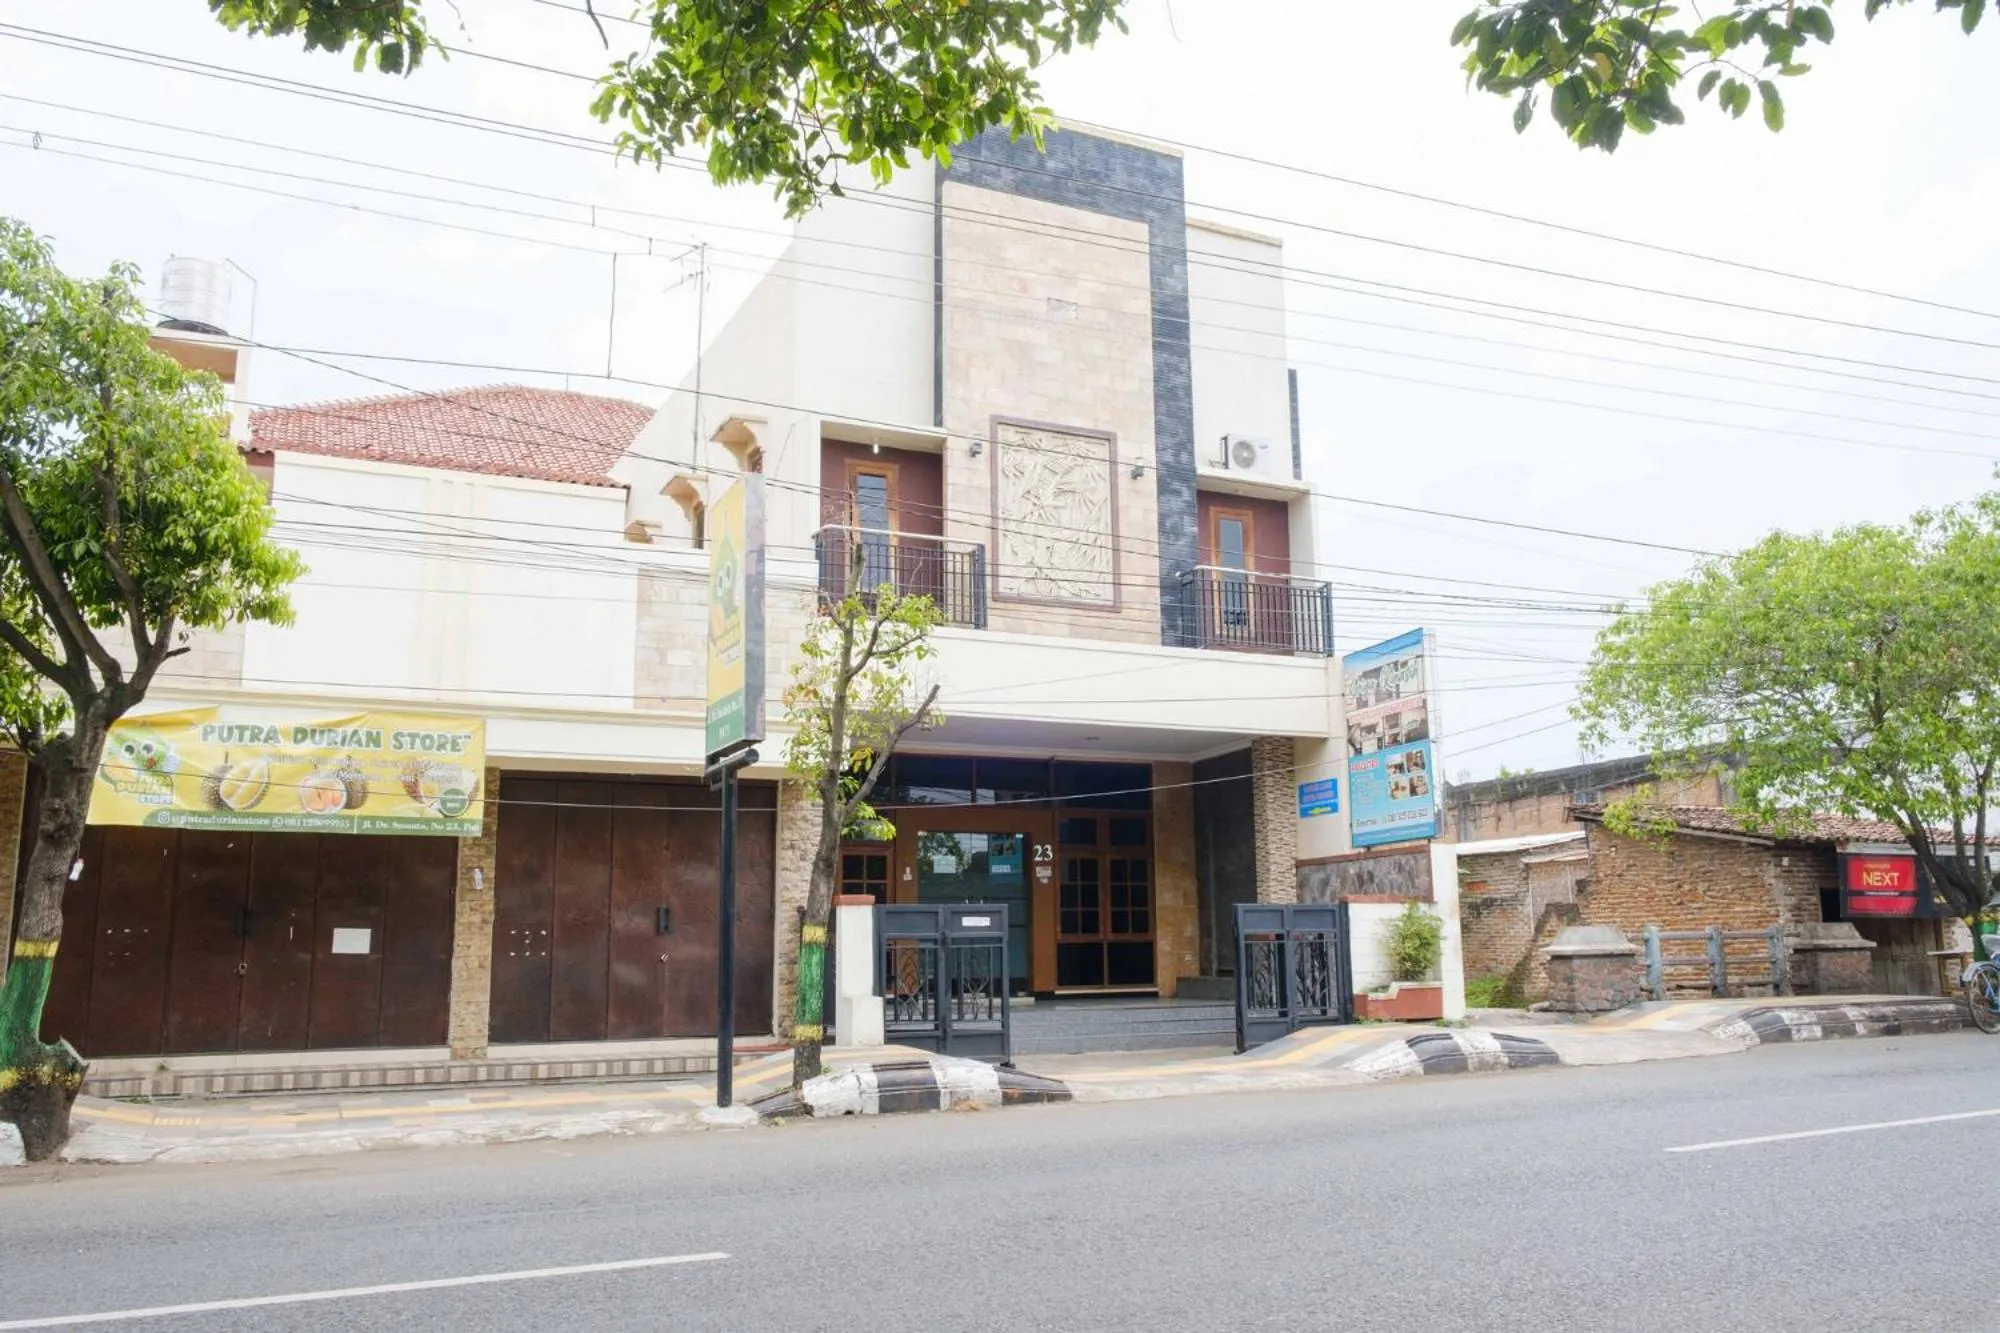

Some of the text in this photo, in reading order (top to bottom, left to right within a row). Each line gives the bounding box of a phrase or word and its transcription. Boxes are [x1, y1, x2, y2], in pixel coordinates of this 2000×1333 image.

[202, 724, 463, 752] PUTRA DURIAN STORE
[1033, 844, 1053, 861] 23
[1863, 871, 1900, 886] NEXT
